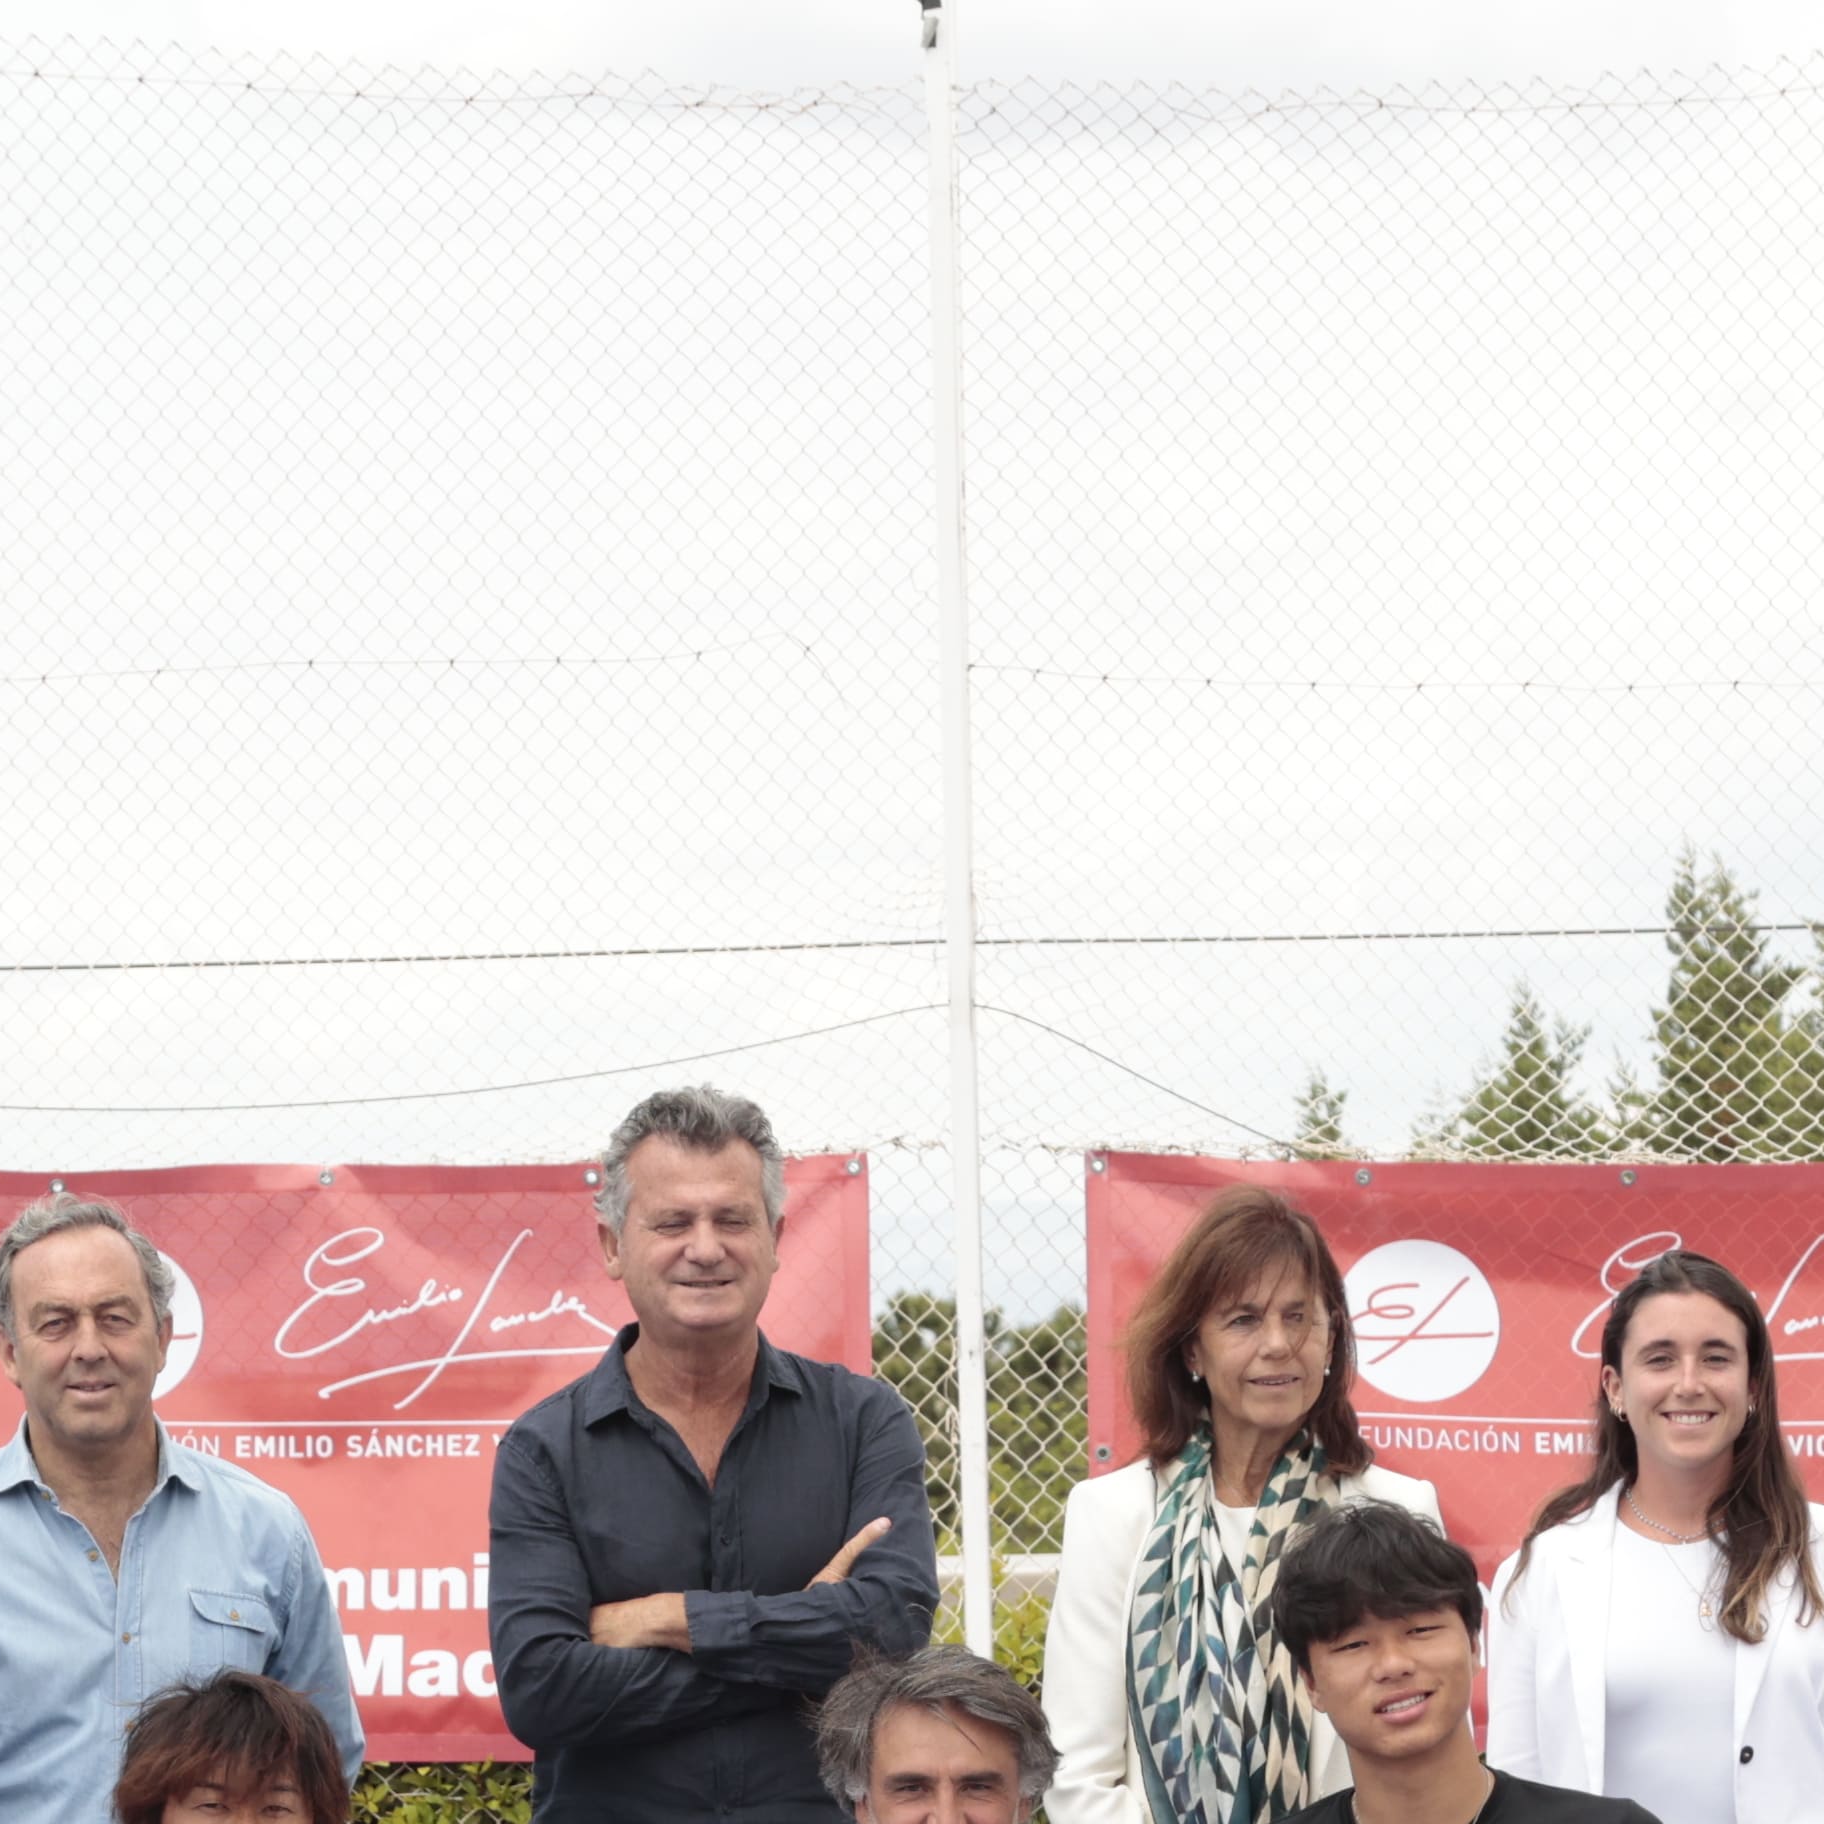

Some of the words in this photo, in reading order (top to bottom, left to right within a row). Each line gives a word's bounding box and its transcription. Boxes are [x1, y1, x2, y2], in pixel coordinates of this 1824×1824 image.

[235, 1434, 334, 1459] EMILIO
[346, 1428, 481, 1458] SÁNCHEZ
[1357, 1425, 1520, 1454] FUNDACIÓN
